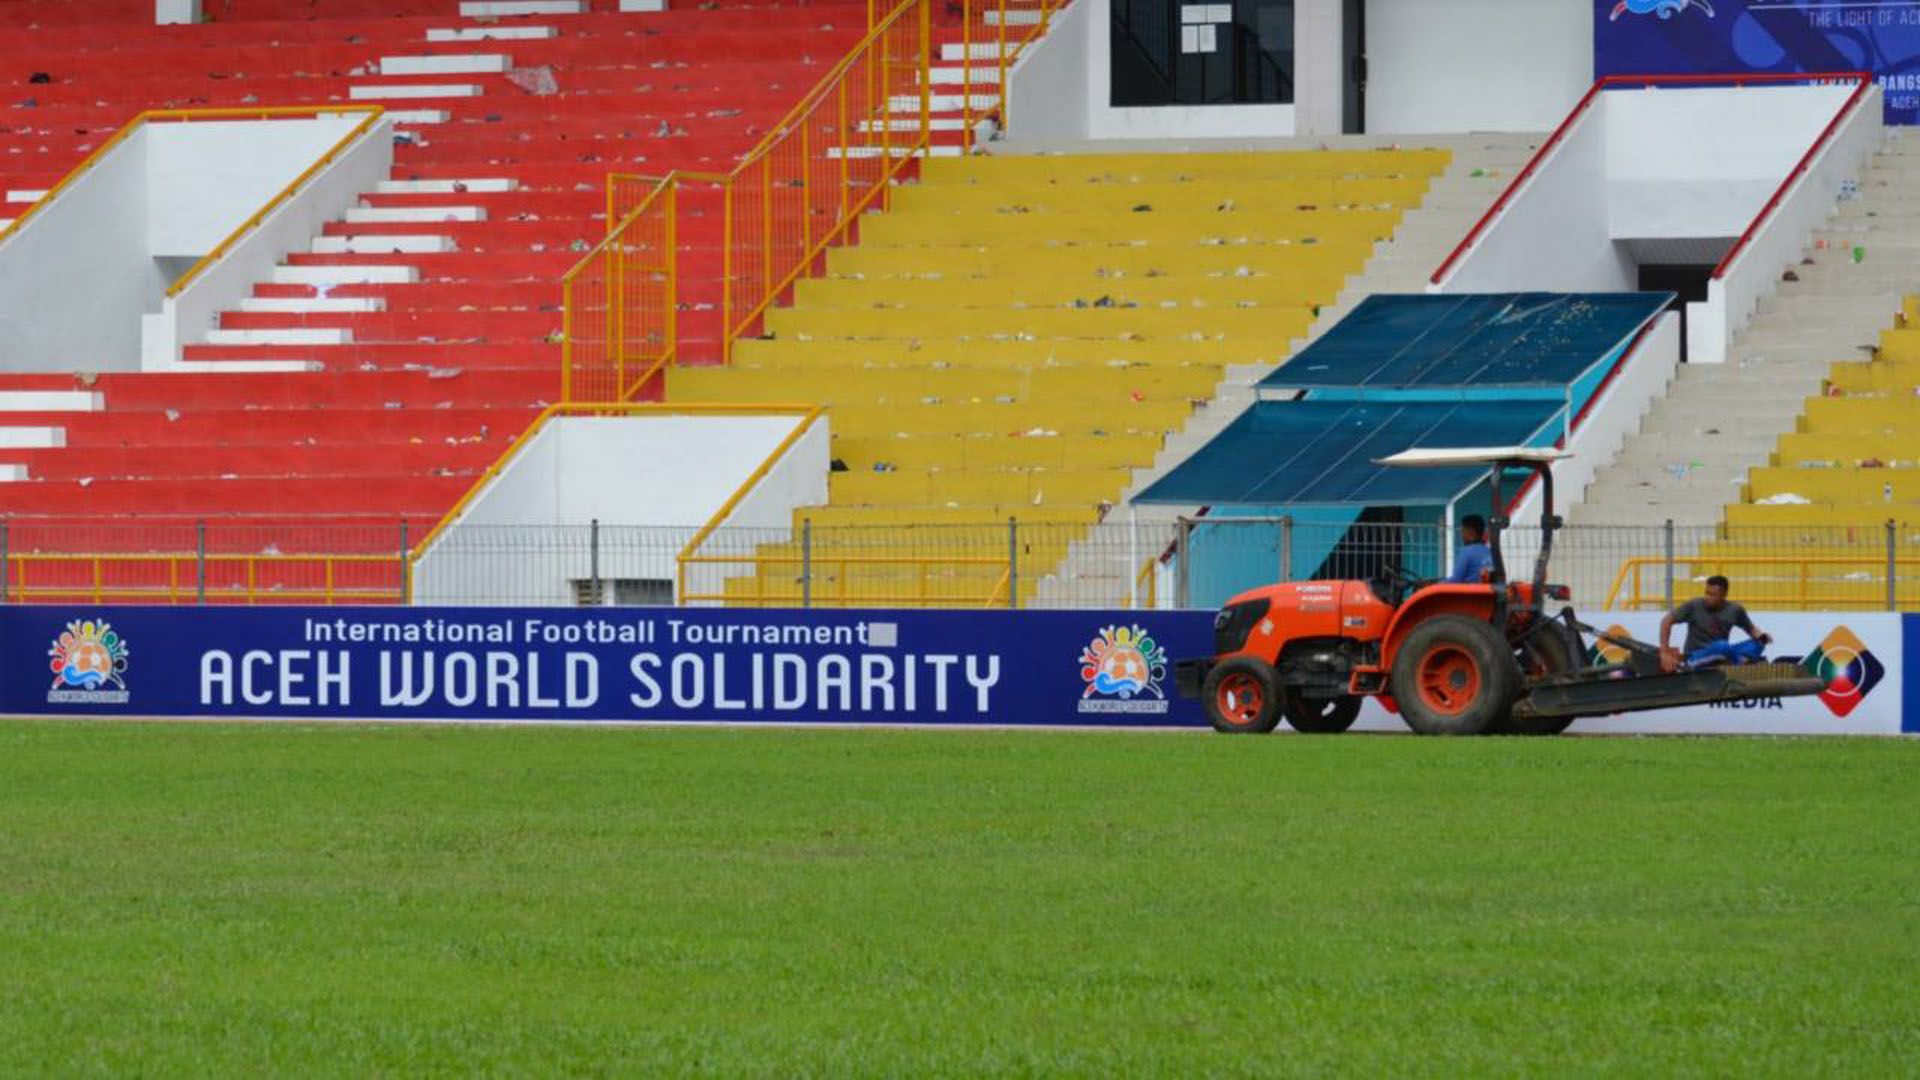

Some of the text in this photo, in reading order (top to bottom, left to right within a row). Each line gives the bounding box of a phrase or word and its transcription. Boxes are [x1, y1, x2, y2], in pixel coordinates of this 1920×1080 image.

[1809, 8, 1920, 28] THE LIGHT OF AC
[305, 618, 869, 646] International Football Tournament
[201, 649, 1000, 712] ACEH WORLD SOLIDARITY
